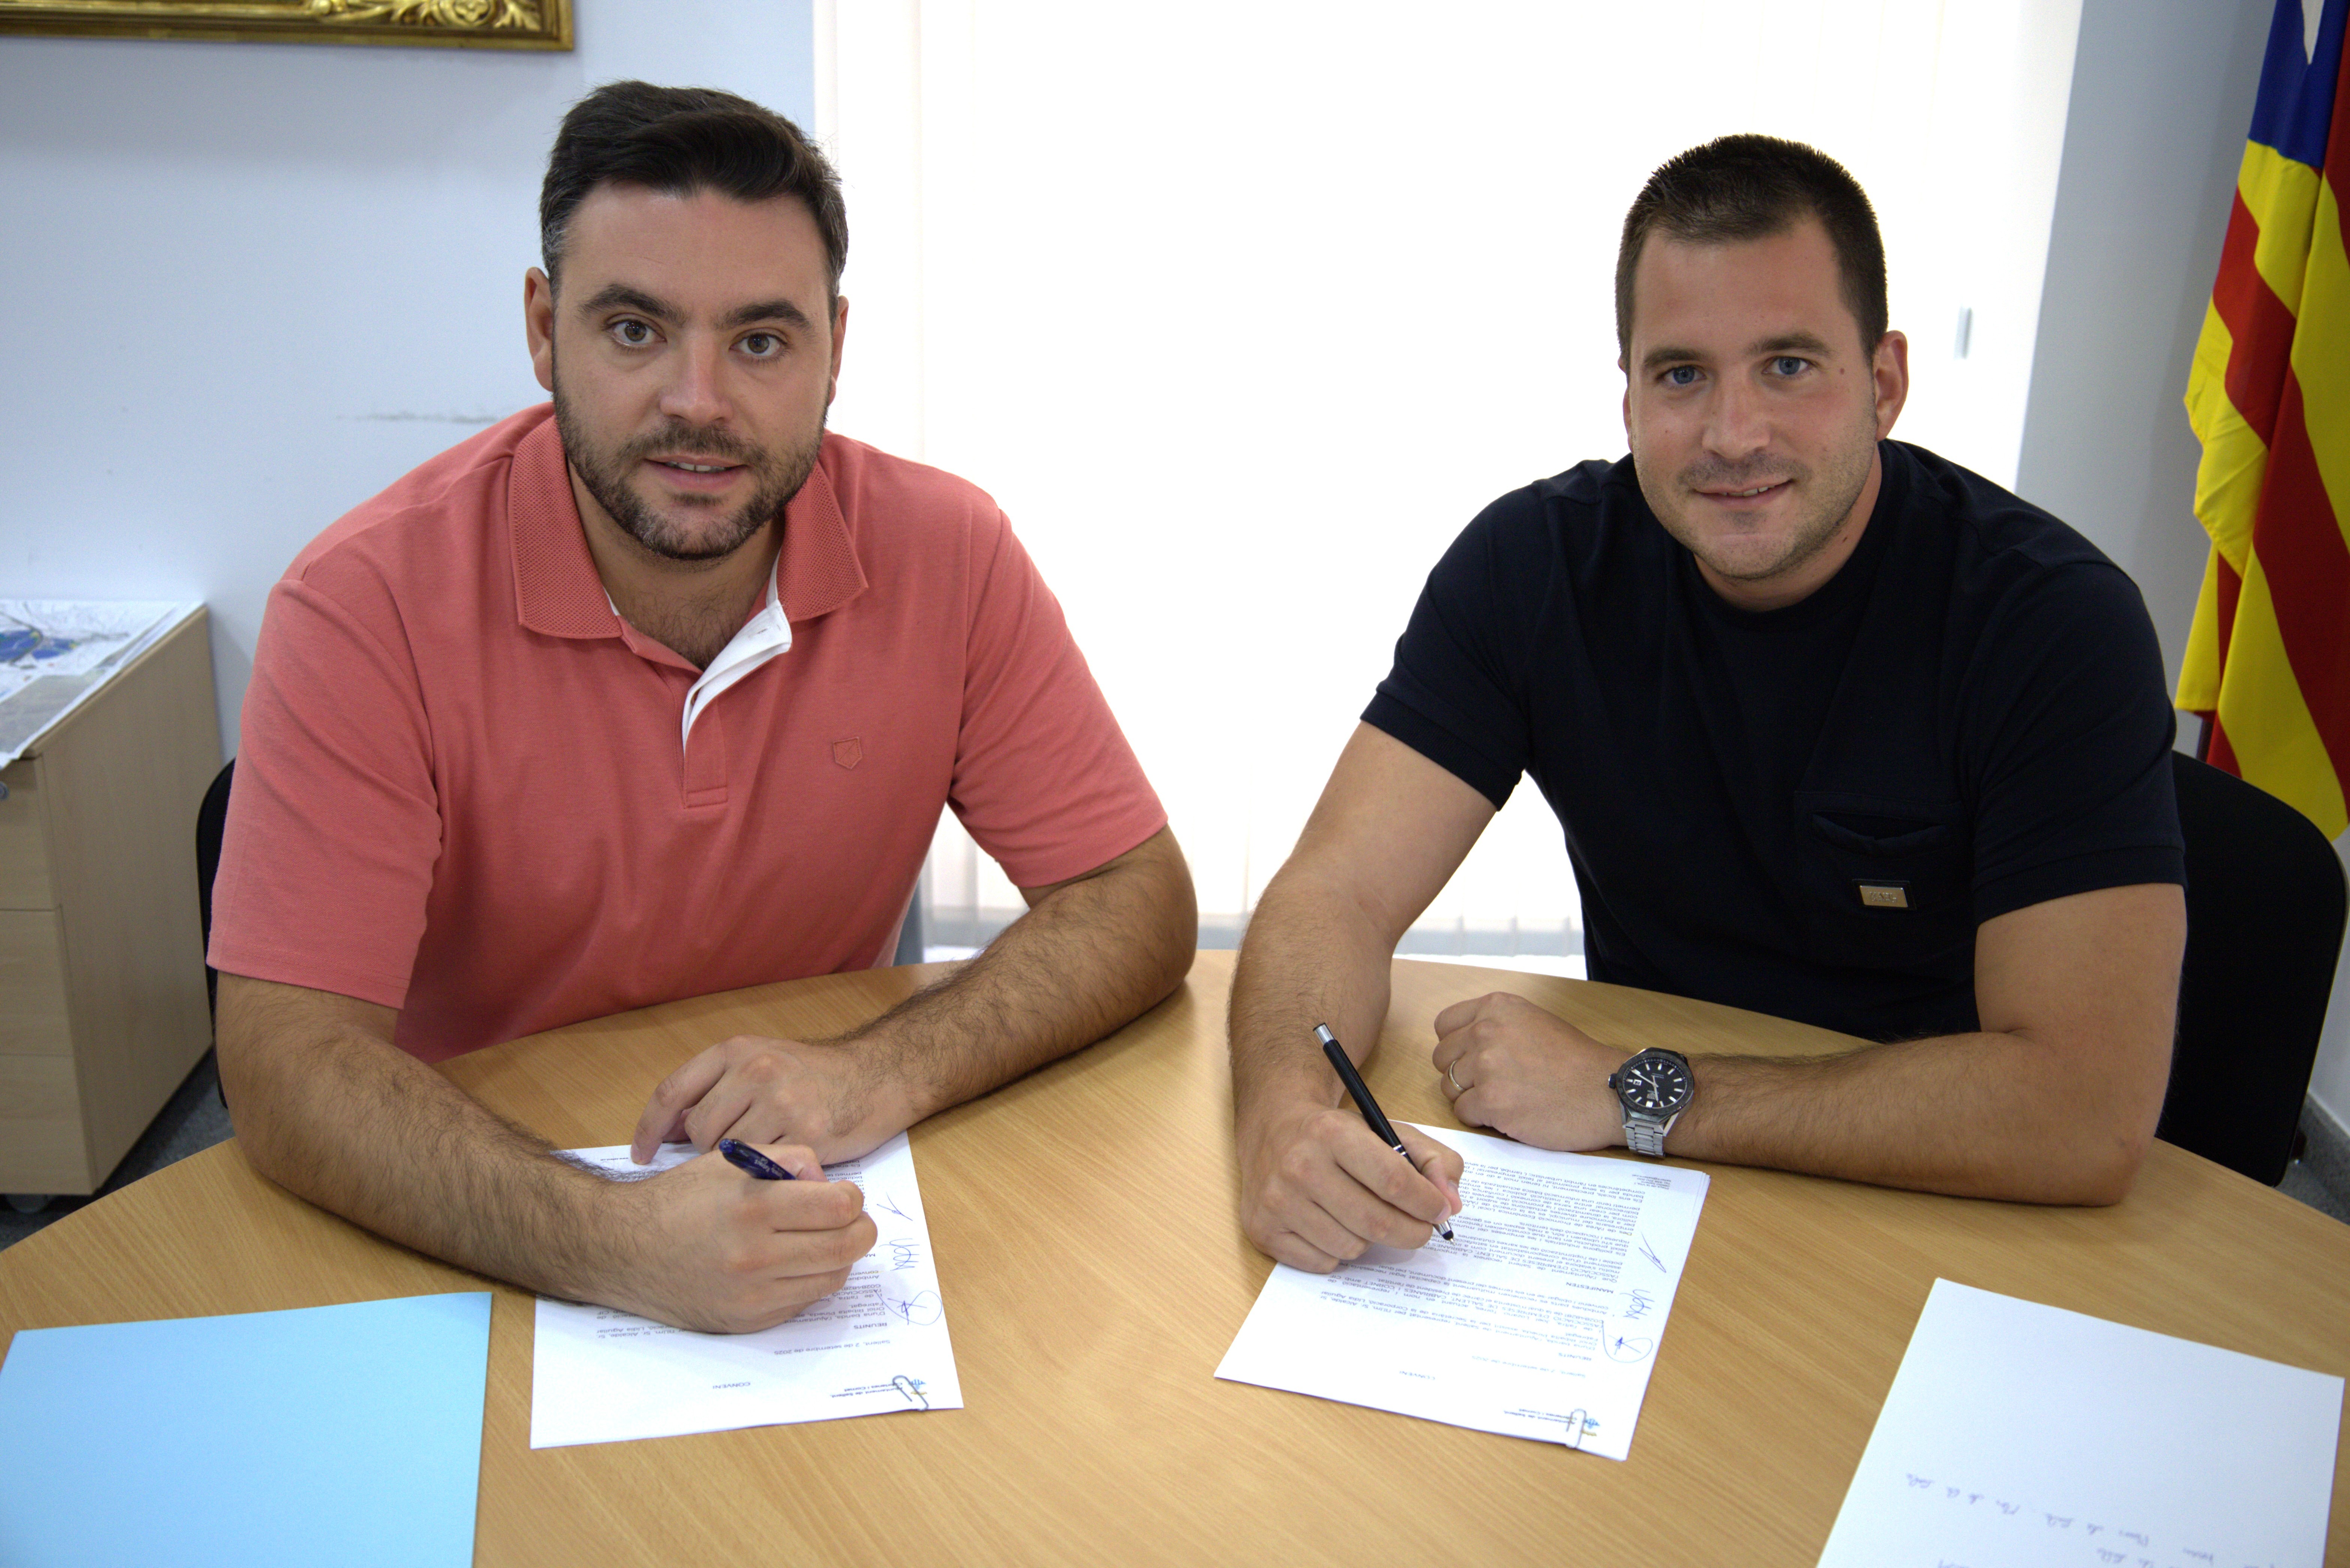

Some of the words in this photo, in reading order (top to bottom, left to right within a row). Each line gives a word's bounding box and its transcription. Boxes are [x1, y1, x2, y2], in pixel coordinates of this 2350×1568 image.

[1499, 1167, 1523, 1175] també,
[1528, 1172, 1563, 1182] urbanístic;
[1470, 1187, 1505, 1197] confiança,
[1551, 1184, 1595, 1196] precisament,
[1597, 1184, 1646, 1196] competències
[1510, 1198, 1544, 1208] promoció
[1497, 1209, 1536, 1219] Econòmica
[1557, 1207, 1602, 1218] dinamització
[1537, 1217, 1572, 1226] Promoció
[1611, 1215, 1637, 1224] millora,
[1518, 1222, 1548, 1230] territoris.
[1490, 1229, 1525, 1238] empreses
[1564, 1229, 1600, 1239] l'ocupació
[1543, 1239, 1581, 1249] industrials
[1603, 1236, 1630, 1245] riquesa
[1431, 1243, 1473, 1253] CABRIANES
[1488, 1248, 1525, 1258] document
[1582, 1245, 1613, 1254] polígons
[1472, 1254, 1503, 1263] reconeix
[1474, 1250, 1508, 1260] SALLENT,
[1527, 1254, 1555, 1263] present
[1540, 1248, 1587, 1260] l'optimització
[1521, 1259, 1569, 1270] D'EMPRESES
[1564, 1262, 1596, 1271] s'elabora
[1550, 1268, 1597, 1280] l'Ajuntament
[1570, 1267, 1619, 1279] l'ASSOCIACIÓ
[1363, 1281, 1395, 1290] CORNET
[1565, 1282, 1614, 1294] MANIFESTEN
[1403, 1288, 1447, 1299] CABRIANES
[1449, 1296, 1484, 1306] SALLENT,
[1501, 1307, 1550, 1319] D'EMPRESES
[783, 1315, 832, 1324] l'Ajuntament
[1552, 1316, 1603, 1329] l'ASSOCIACIÓ
[1557, 1352, 1592, 1361] REUNITS
[1399, 1370, 1436, 1380] CONVENI
